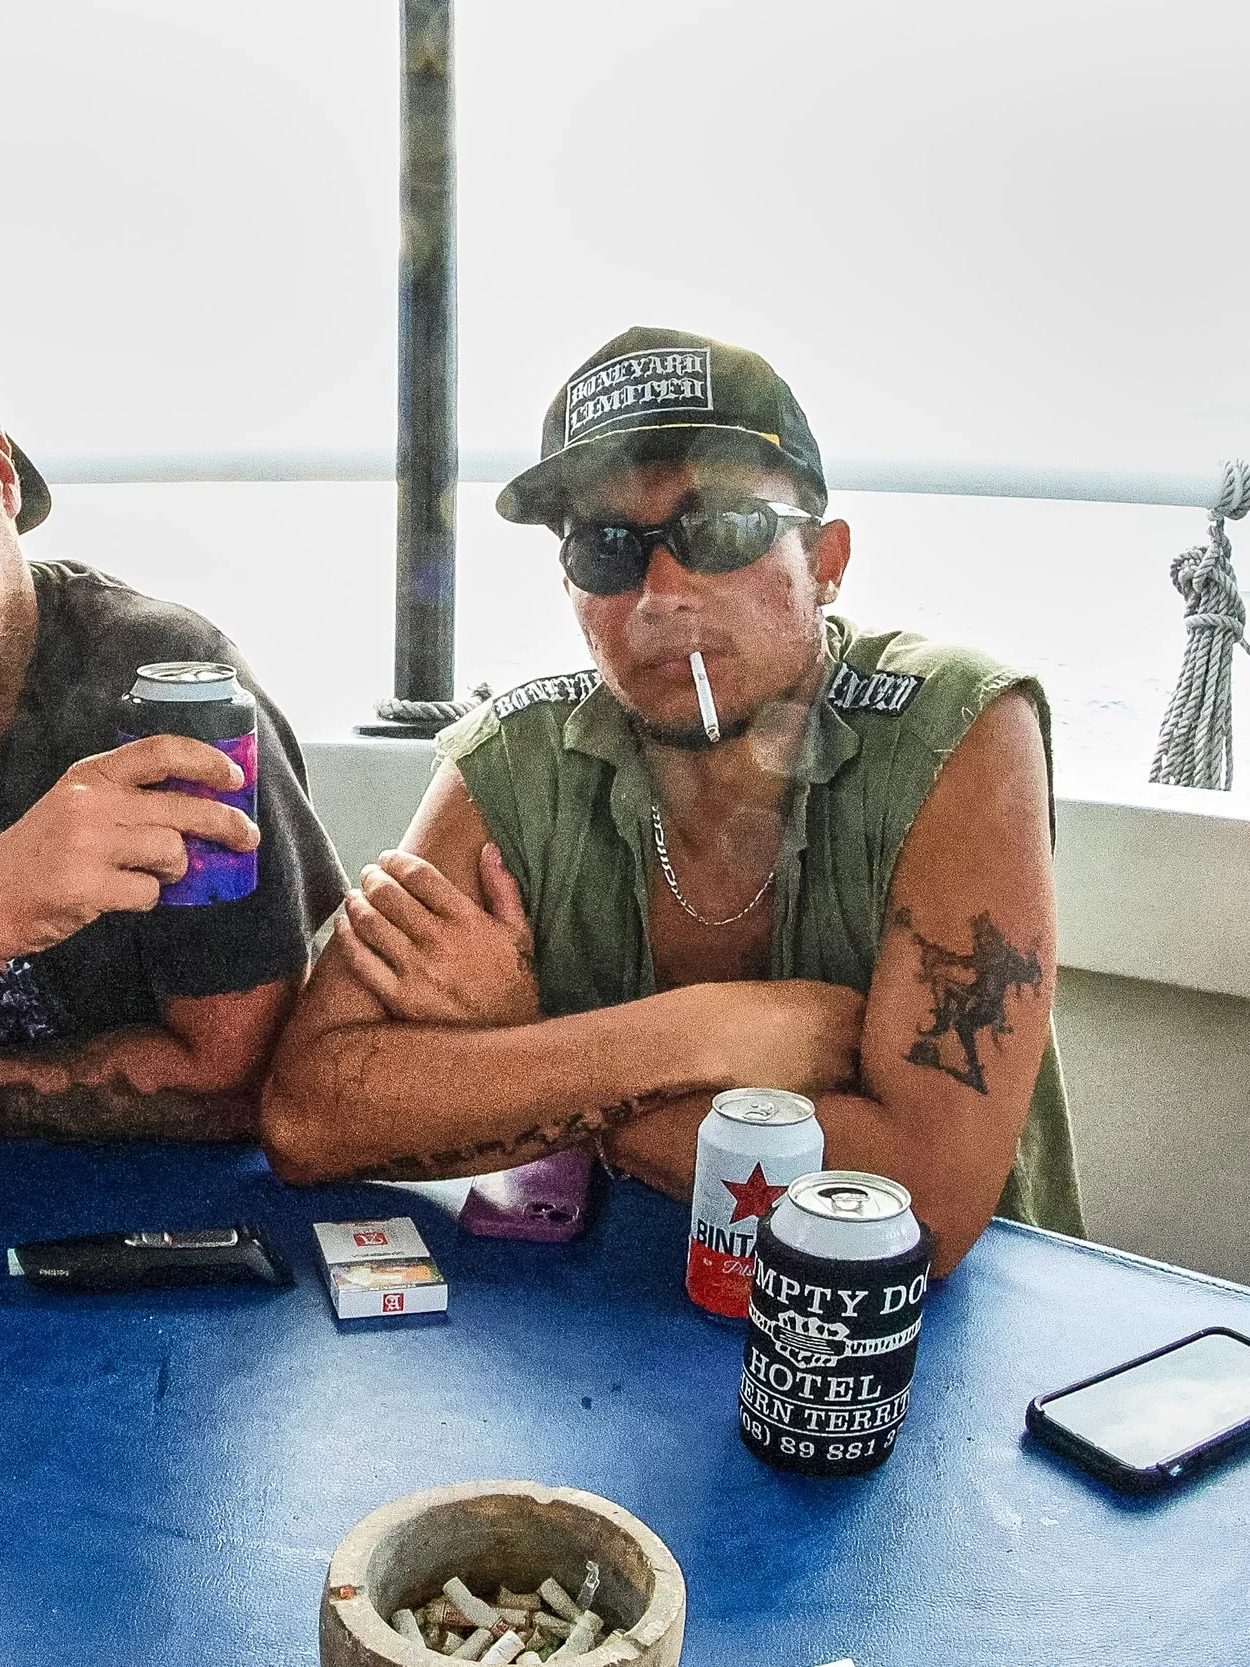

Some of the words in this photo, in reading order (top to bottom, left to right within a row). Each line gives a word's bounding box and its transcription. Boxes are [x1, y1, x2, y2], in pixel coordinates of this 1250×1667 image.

[570, 354, 703, 408] BONEYARD
[570, 377, 705, 435] LIMITED
[494, 673, 601, 719] BONEYA
[696, 1218, 755, 1258] BINT
[753, 1250, 868, 1317] MPTY
[879, 1263, 931, 1315] DO
[750, 1347, 882, 1401] HOTEL
[804, 1389, 910, 1431] TERRIT
[780, 1437, 815, 1458] 89
[826, 1439, 876, 1460] 881
